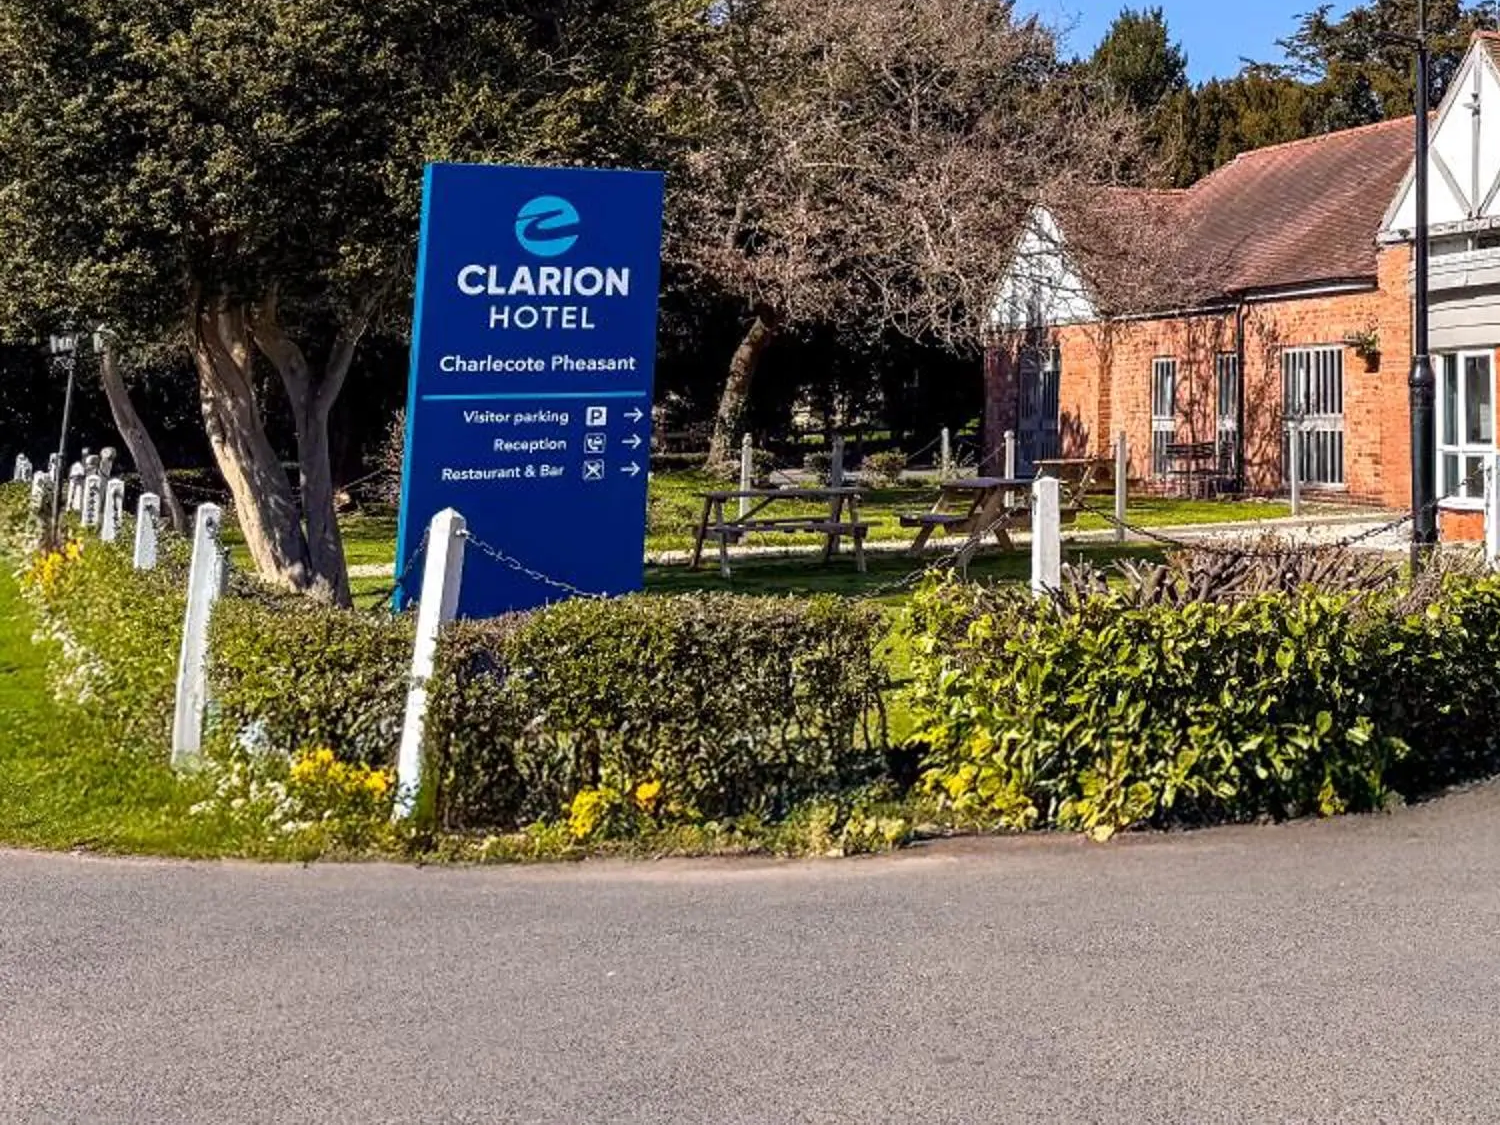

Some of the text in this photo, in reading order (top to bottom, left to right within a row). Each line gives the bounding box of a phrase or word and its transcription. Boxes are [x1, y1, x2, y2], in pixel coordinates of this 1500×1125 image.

[457, 264, 630, 296] CLARION
[489, 305, 595, 329] HOTEL
[439, 354, 636, 372] Charlecote Pheasant
[463, 410, 511, 424] Visitor
[513, 410, 569, 426] parking
[493, 437, 567, 453] Reception
[441, 464, 565, 481] Restaurant & Bar
